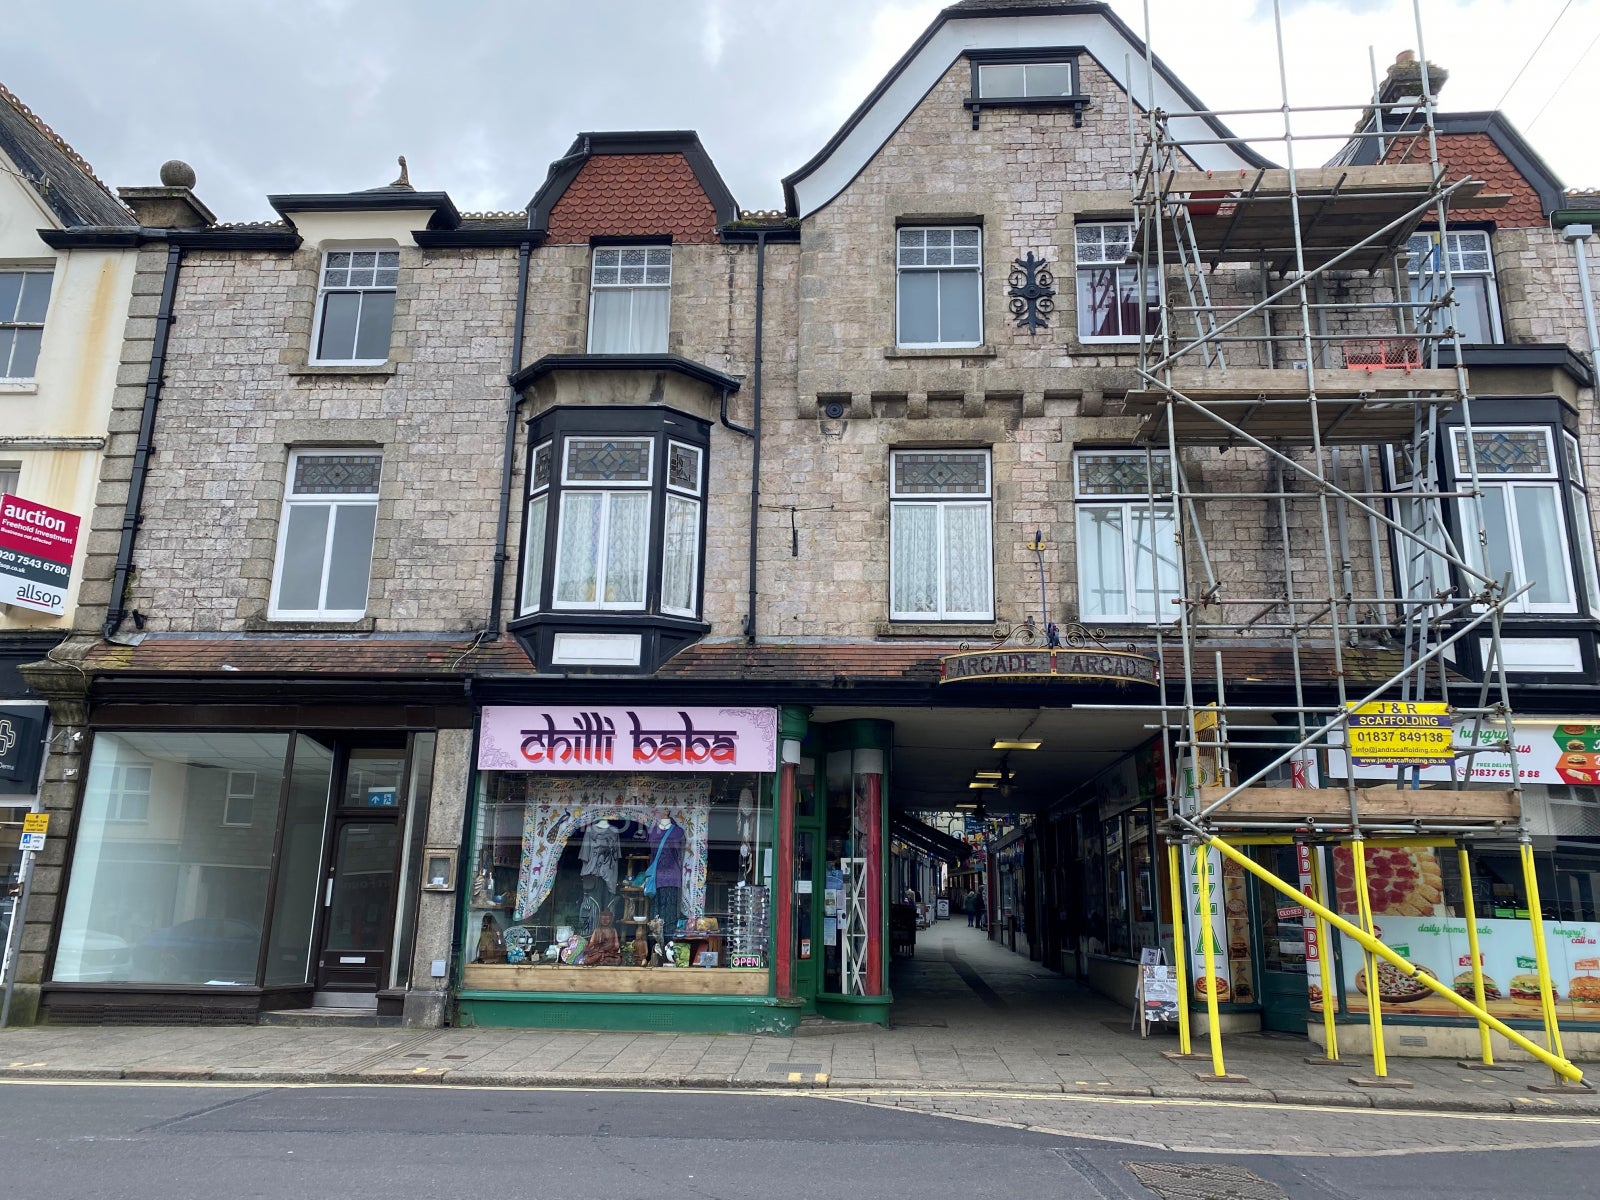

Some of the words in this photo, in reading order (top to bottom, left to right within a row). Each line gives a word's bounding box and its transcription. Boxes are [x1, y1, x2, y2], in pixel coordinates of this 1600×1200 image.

[4, 504, 66, 533] auction
[2, 518, 34, 533] Freehold
[35, 528, 73, 545] Investment
[17, 555, 42, 569] 7543
[43, 562, 67, 575] 6780
[16, 583, 62, 608] allsop
[957, 654, 1038, 676] ARCADE
[1378, 702, 1386, 714] J
[1391, 702, 1402, 714] &
[1406, 703, 1418, 714] R
[1359, 716, 1439, 726] SCAFFOLDING
[520, 711, 616, 763] chilli
[625, 711, 739, 763] baba
[1357, 731, 1395, 742] 01837
[1399, 731, 1443, 743] 849138
[1360, 757, 1447, 765] www.jandrscaffolding.co.uk
[1498, 769, 1511, 777] 65
[1527, 770, 1540, 778] 88
[1279, 907, 1303, 917] CLOSED
[1418, 923, 1442, 936] daily
[1552, 927, 1586, 938] hungry?
[1571, 936, 1586, 944] call
[732, 957, 759, 967] OPEN
